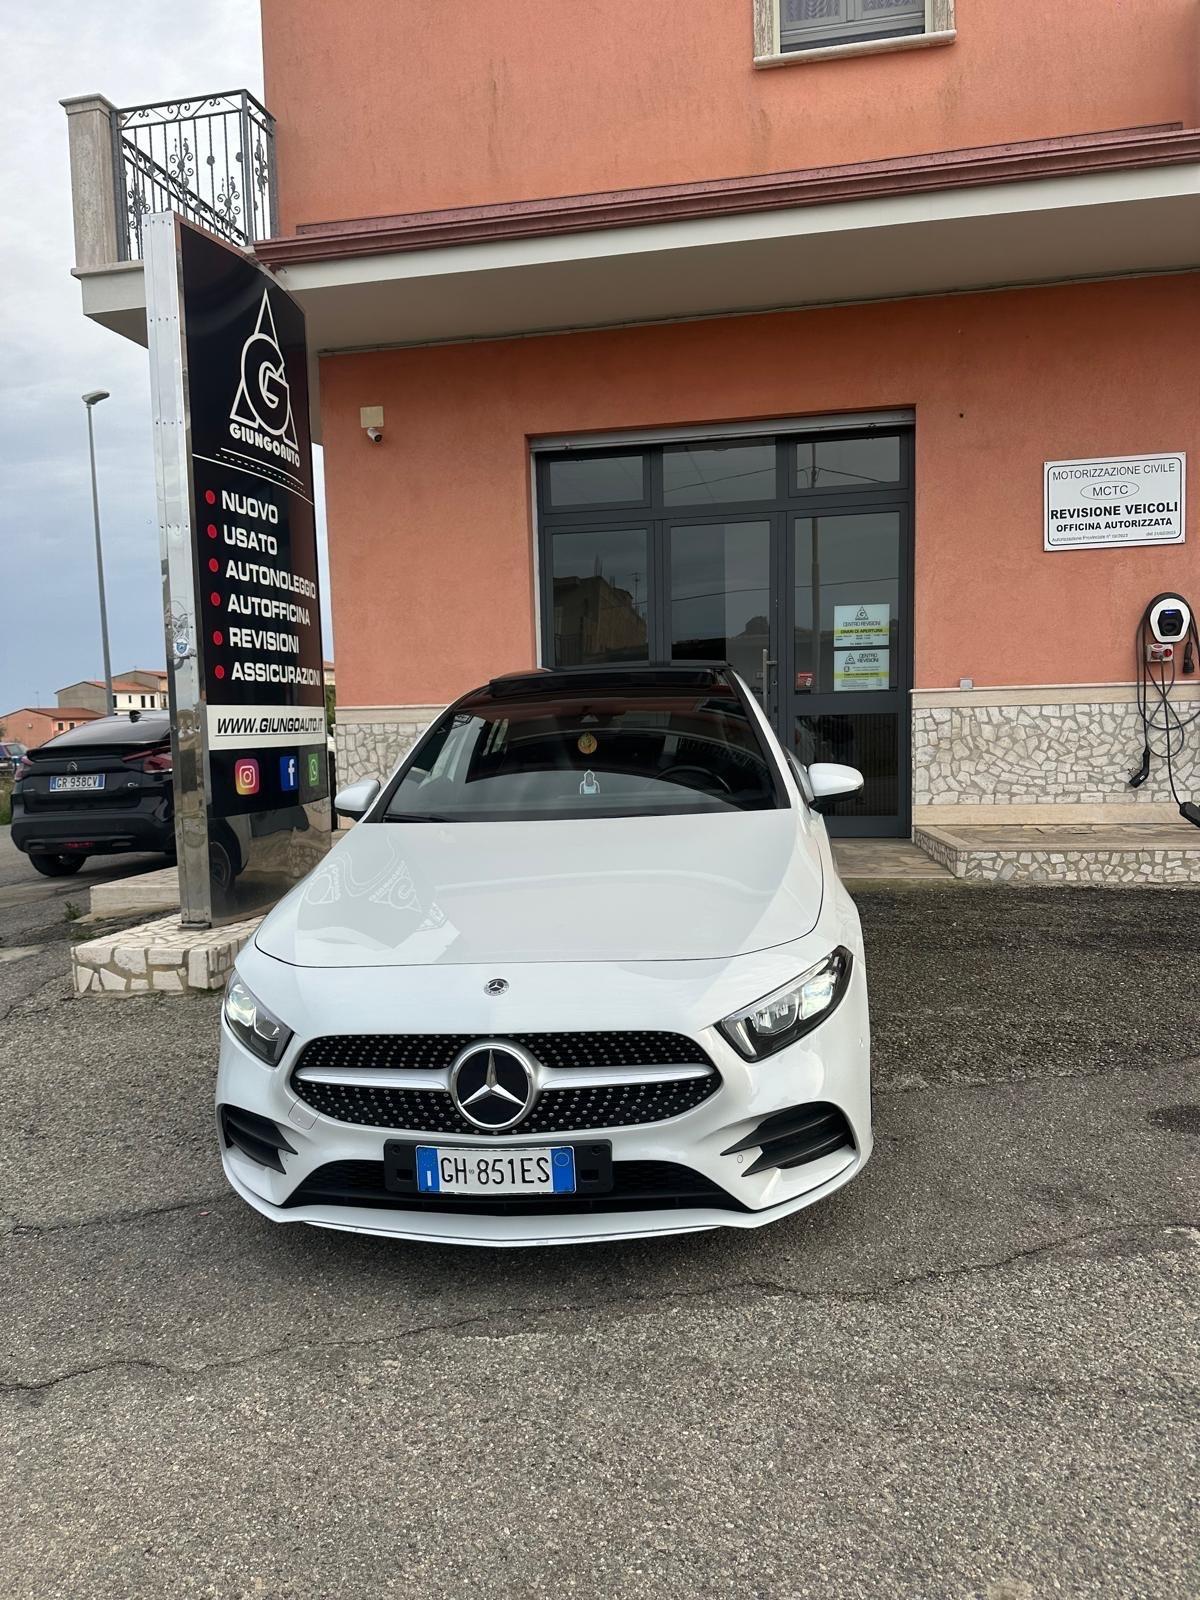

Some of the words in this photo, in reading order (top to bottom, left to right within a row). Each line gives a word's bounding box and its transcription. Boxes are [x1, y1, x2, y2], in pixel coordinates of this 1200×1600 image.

[229, 422, 300, 468] GIUNGOAUTO
[1052, 464, 1141, 481] MOTORIZZAZIONE
[1143, 462, 1175, 474] CIVILE
[1092, 484, 1129, 497] MCTC
[221, 489, 279, 524] NUOVO
[1050, 505, 1121, 520] REVISIONE
[1125, 501, 1178, 515] VEICOLI
[1056, 523, 1101, 533] OFFICINA
[1104, 517, 1173, 530] AUTORIZZATA
[223, 524, 278, 556] USATO
[225, 559, 317, 600] AUTONOLEGGIO
[227, 593, 311, 626] AUTOFFICINA
[229, 627, 299, 653] REVISIONI
[231, 661, 320, 686] ASSICURAZIONI
[217, 718, 323, 734] WWW.GIUNGOAUTO.IT
[56, 777, 67, 788] GR
[70, 775, 98, 787] 938CV
[440, 1157, 468, 1184] GH
[477, 1156, 550, 1184] 851ES
